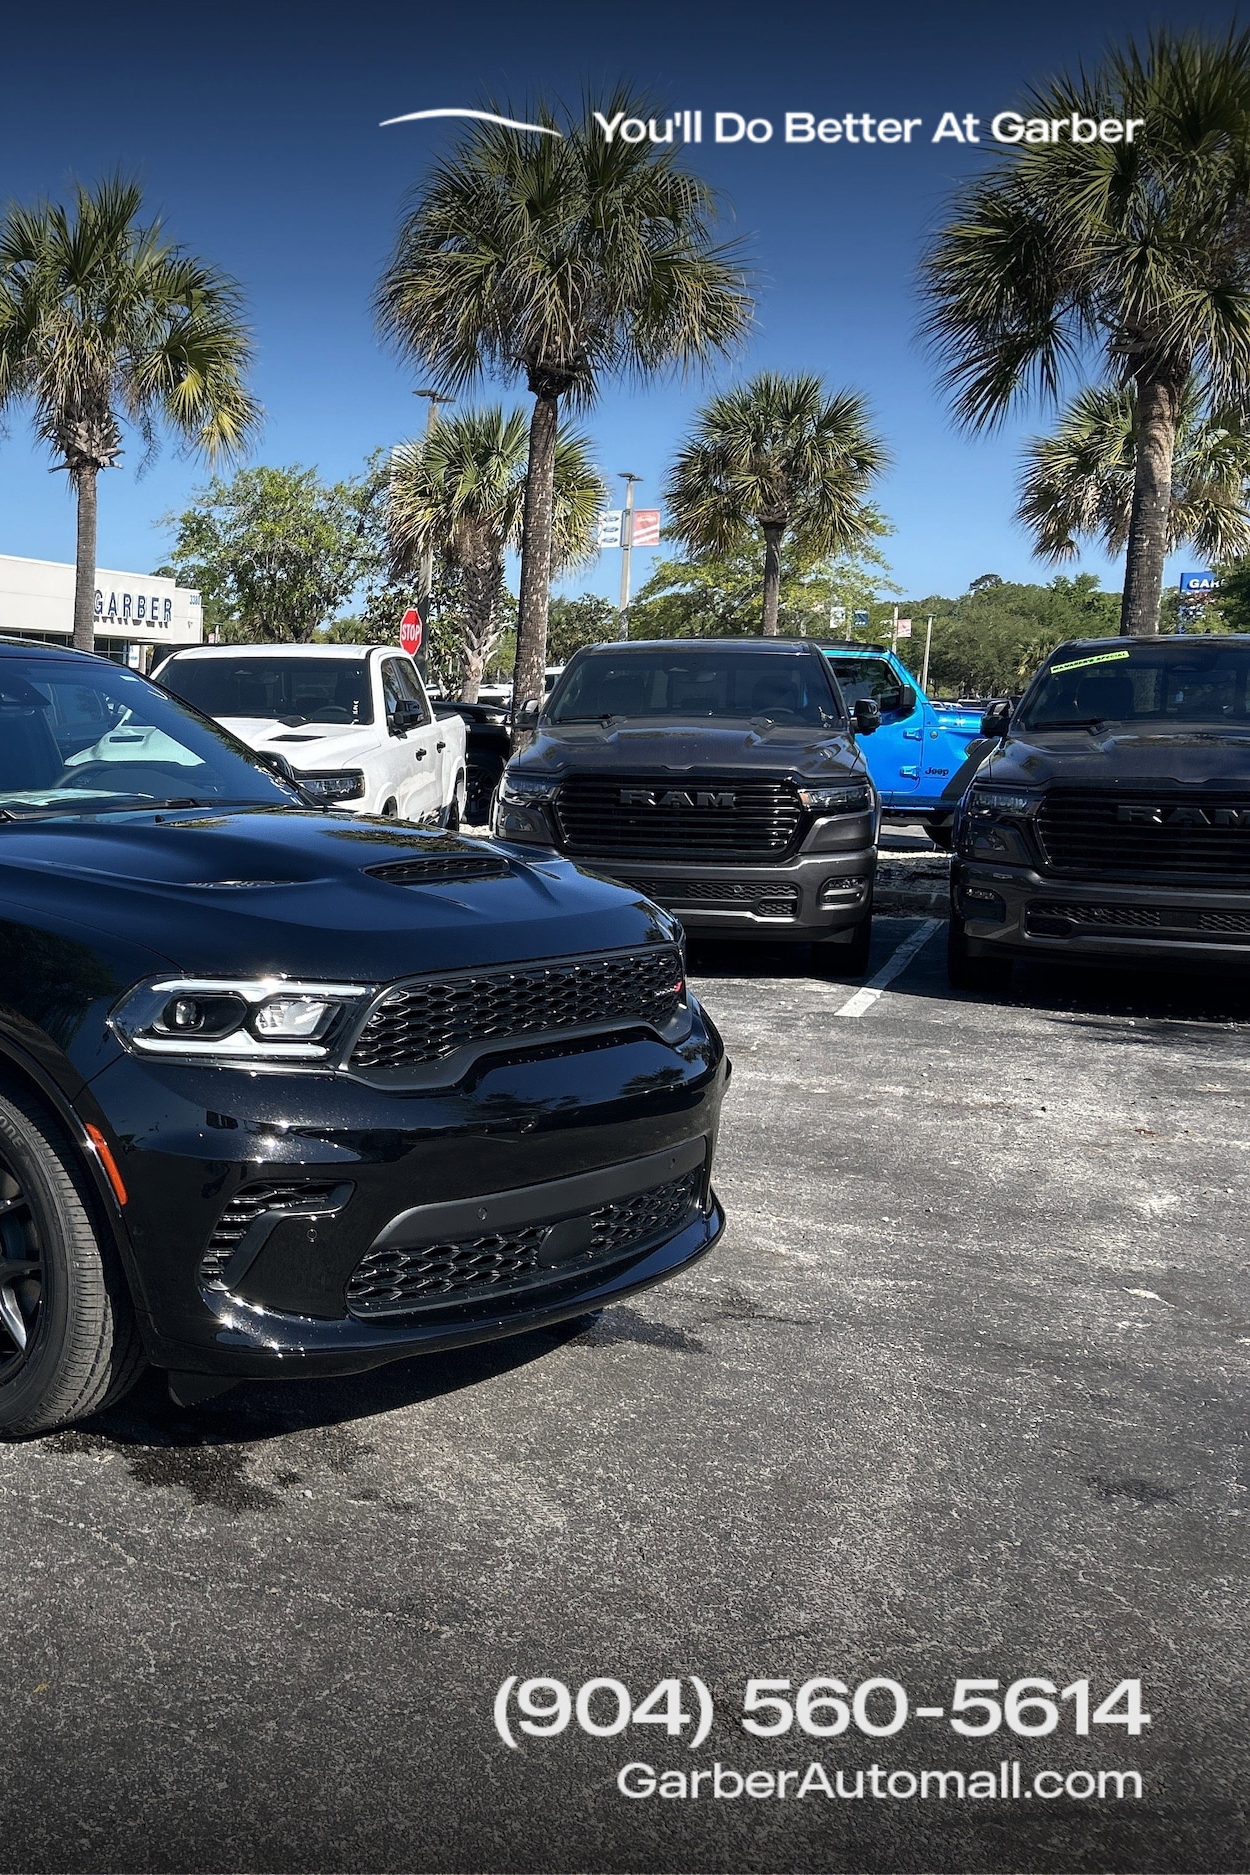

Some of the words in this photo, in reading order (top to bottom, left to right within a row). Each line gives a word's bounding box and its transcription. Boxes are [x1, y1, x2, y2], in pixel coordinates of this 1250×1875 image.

[93, 589, 172, 622] GARBER
[401, 623, 421, 641] STOP
[925, 767, 949, 777] Jeep
[619, 788, 736, 808] RAM
